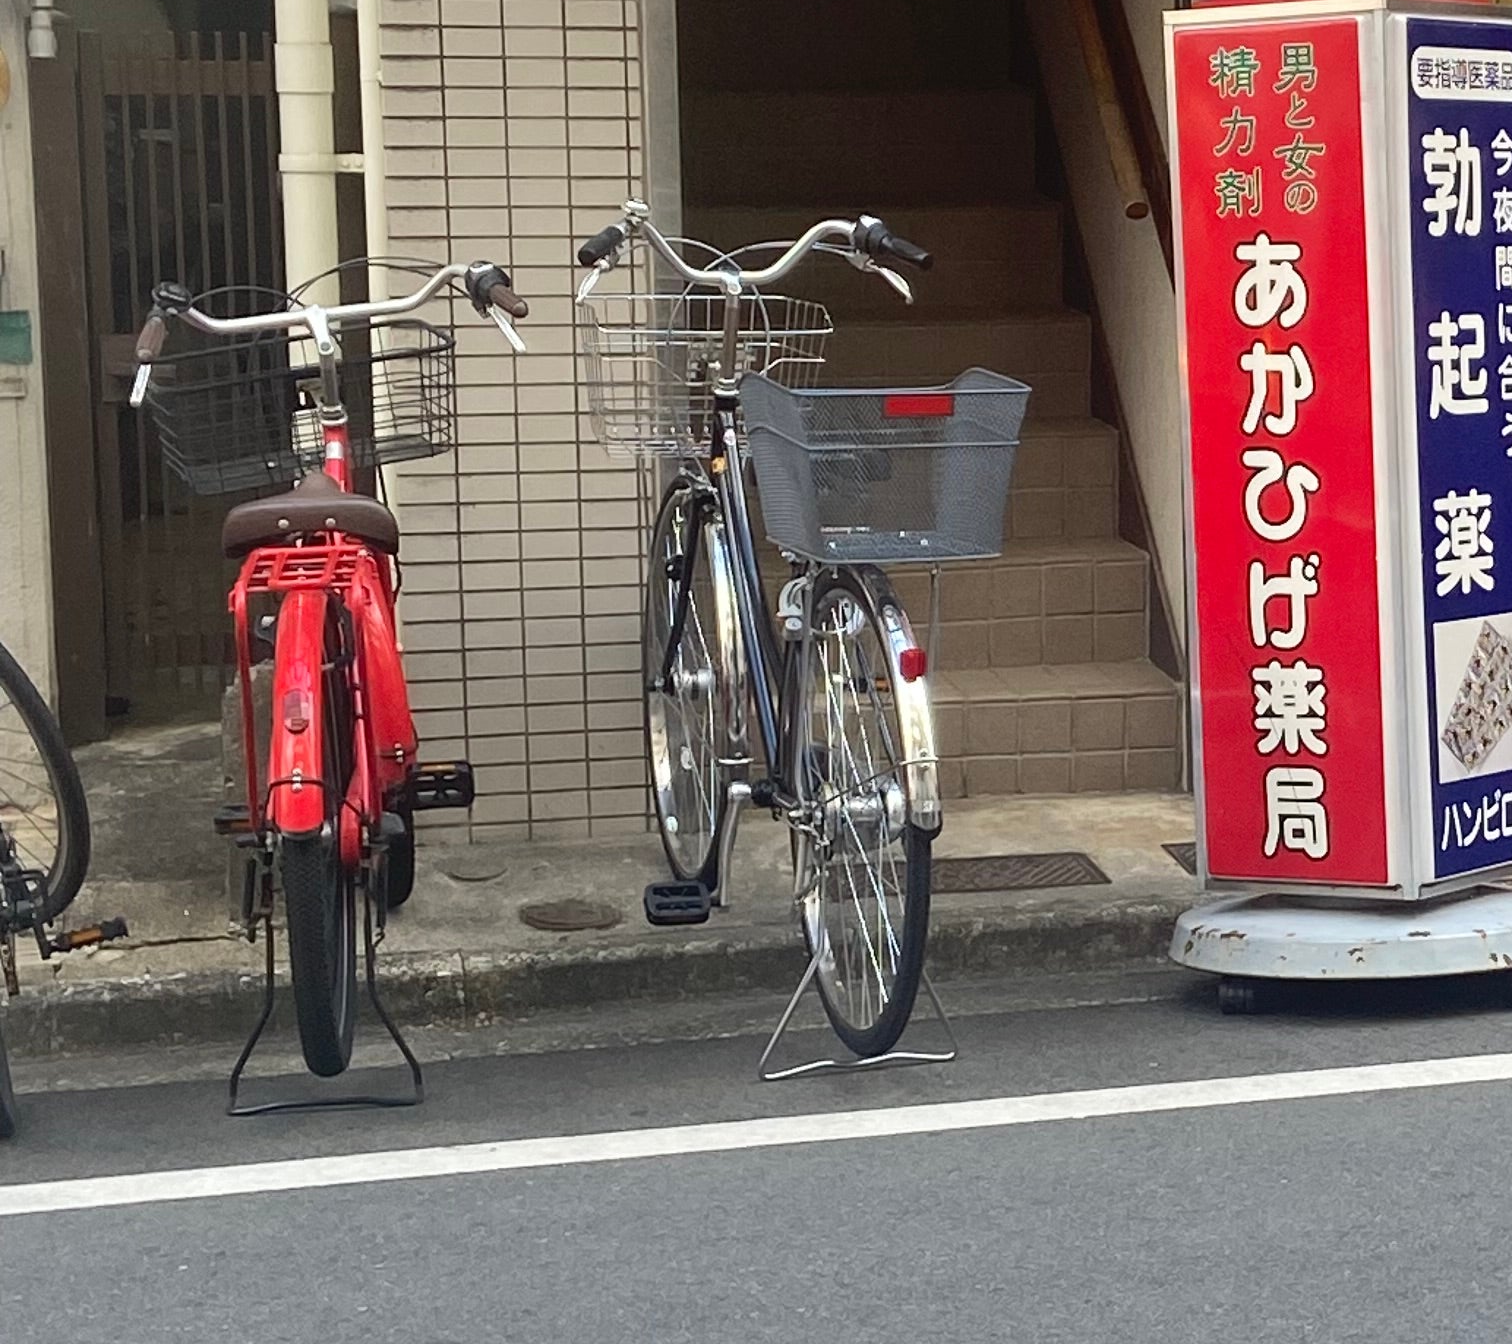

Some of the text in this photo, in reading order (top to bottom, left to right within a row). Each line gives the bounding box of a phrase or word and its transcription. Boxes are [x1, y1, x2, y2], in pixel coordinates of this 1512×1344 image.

[1208, 46, 1264, 218] 精力剤
[1273, 42, 1326, 215] 男と女の
[1421, 126, 1496, 598] 勃起薬
[1231, 231, 1331, 860] あかひげ薬局
